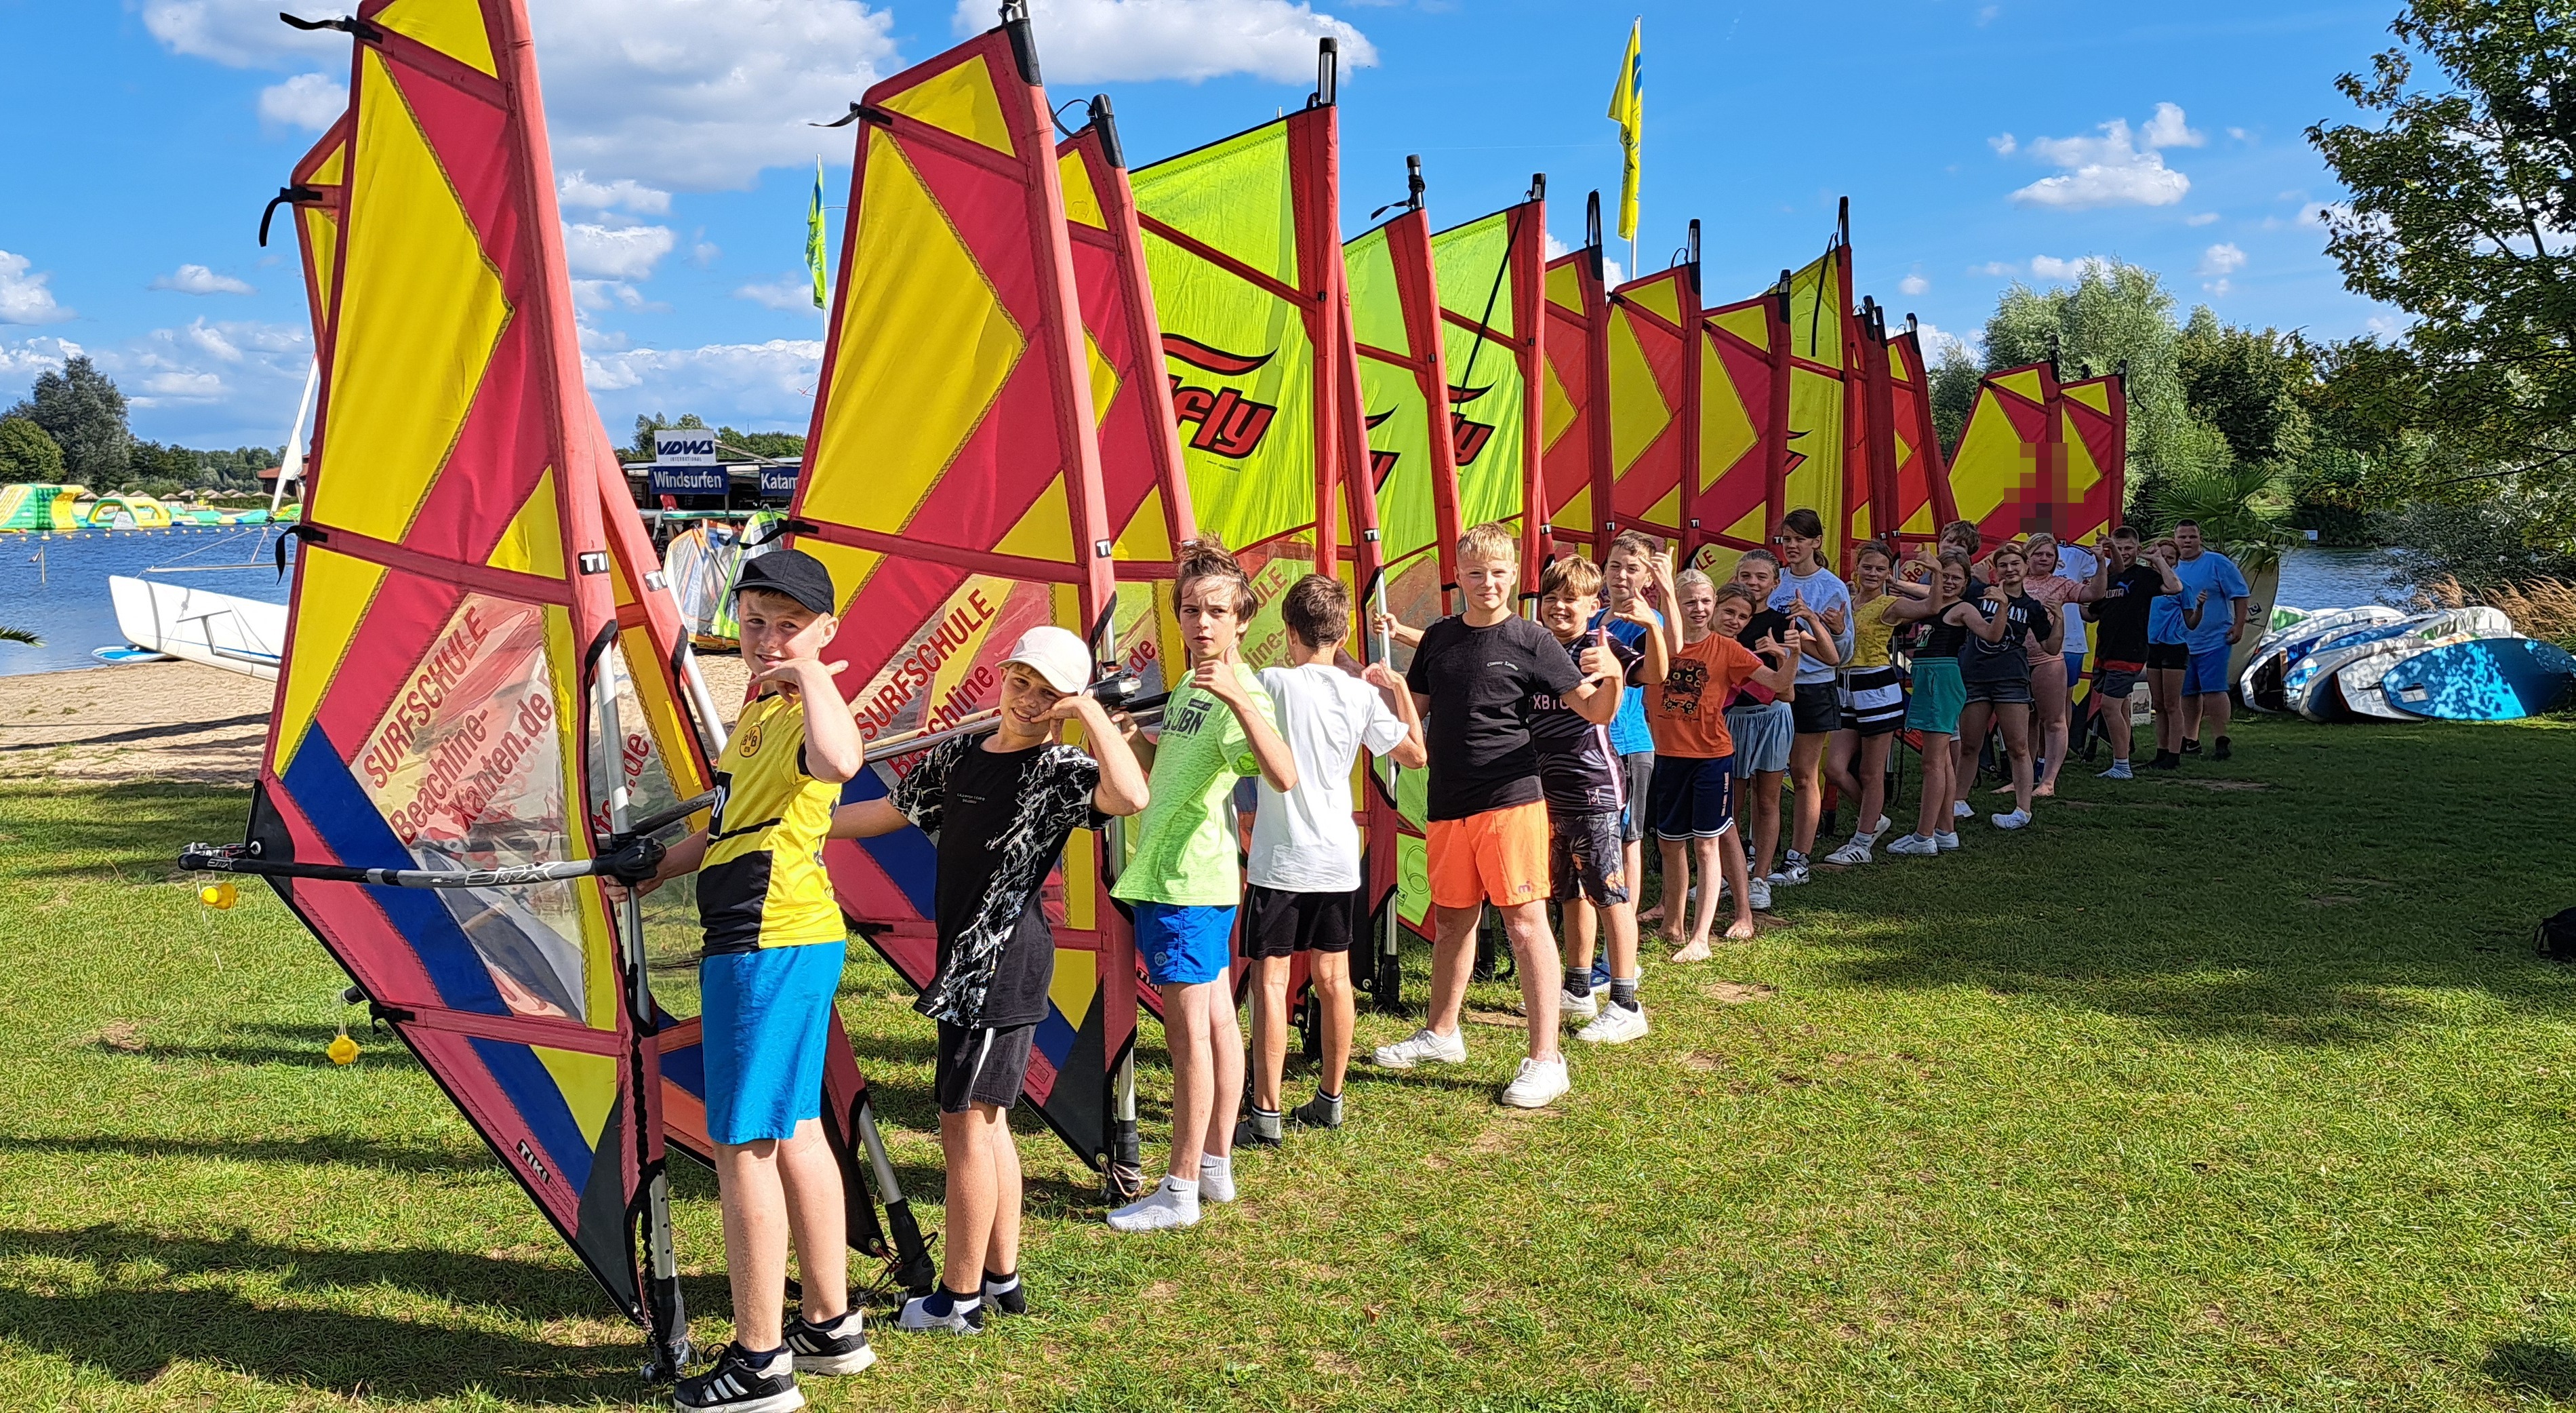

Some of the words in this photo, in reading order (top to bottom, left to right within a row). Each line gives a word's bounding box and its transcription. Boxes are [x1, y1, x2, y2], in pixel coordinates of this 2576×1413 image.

[1168, 374, 1279, 460] fly
[656, 441, 714, 455] VDWS
[653, 471, 721, 488] Windsurfen
[580, 553, 609, 572] TI
[2104, 589, 2124, 598] UMA
[1980, 599, 2028, 623] NIANA
[855, 589, 996, 740] SURFSCHULE
[363, 605, 488, 789] SURFSCHULE
[742, 730, 758, 747] BVB
[449, 693, 552, 831] Xanten.de
[389, 709, 488, 845] Beachline-
